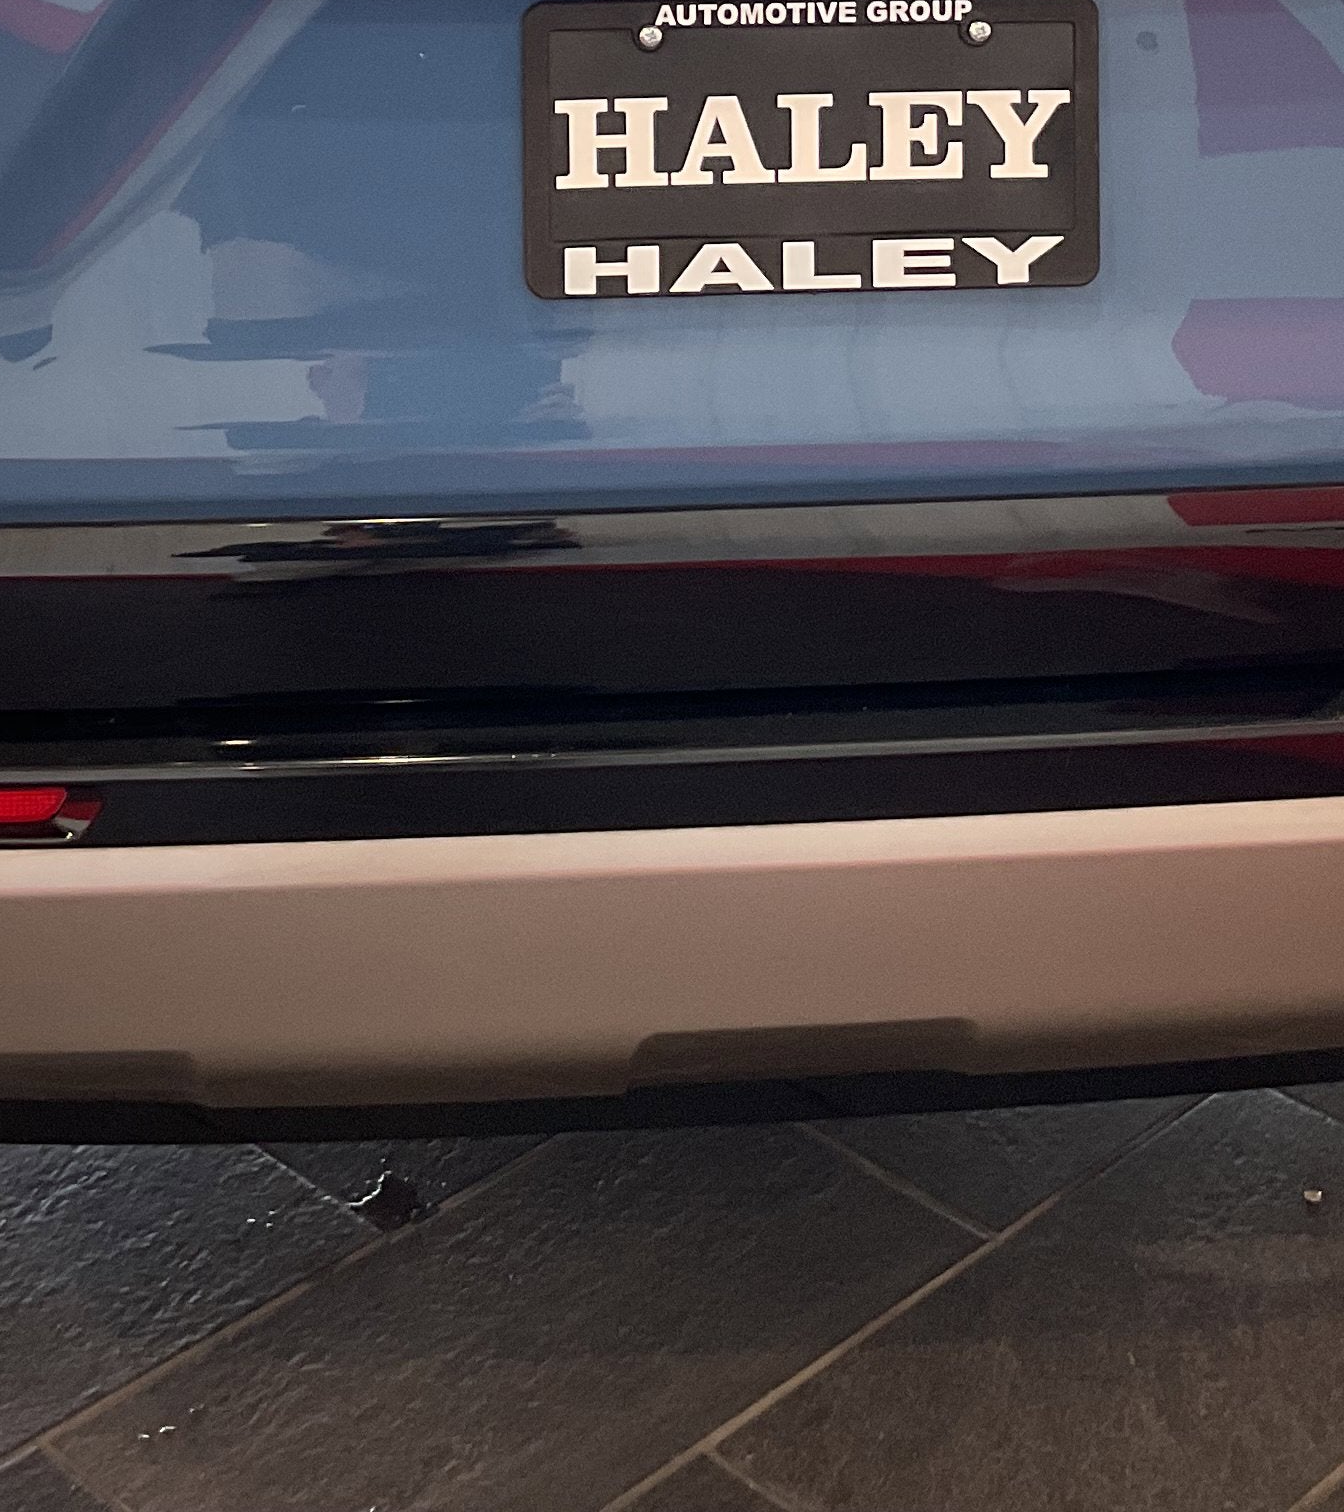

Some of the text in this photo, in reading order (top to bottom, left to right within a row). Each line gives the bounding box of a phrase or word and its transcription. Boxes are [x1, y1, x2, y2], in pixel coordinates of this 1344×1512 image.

[654, 0, 858, 27] AUTOMOTIVE
[554, 89, 1071, 190] HALEY
[563, 234, 1065, 296] HALEY
